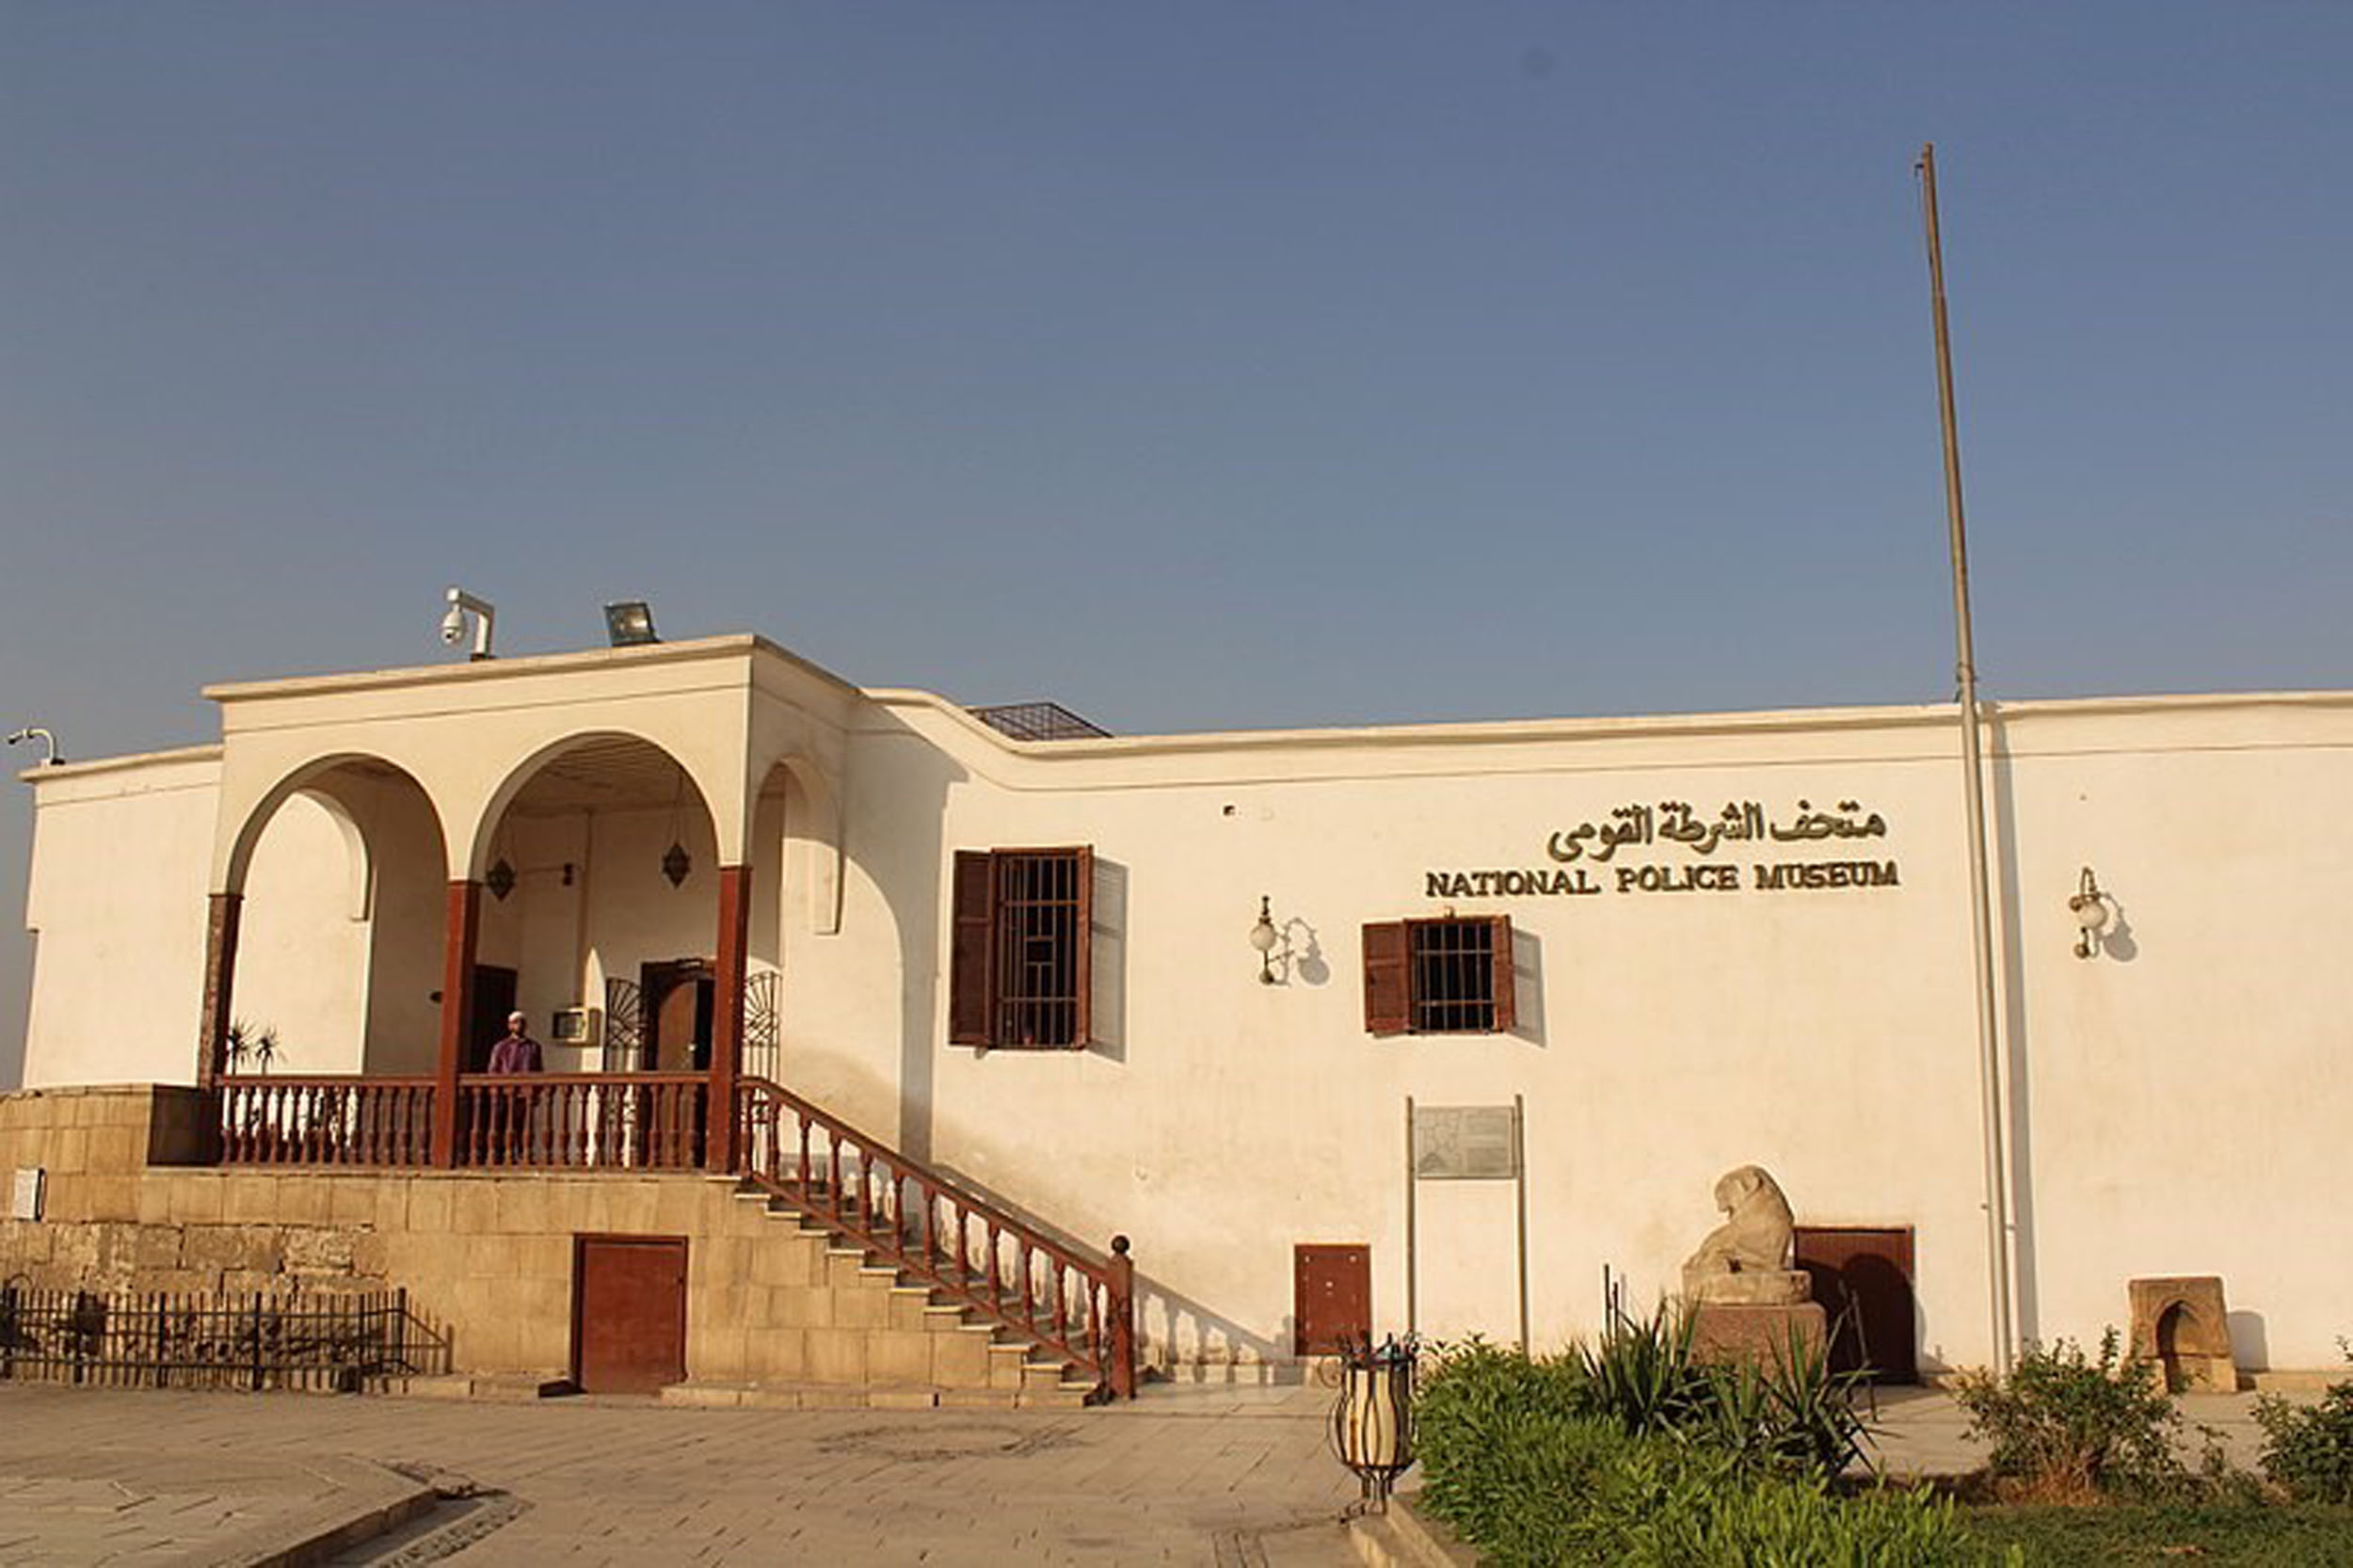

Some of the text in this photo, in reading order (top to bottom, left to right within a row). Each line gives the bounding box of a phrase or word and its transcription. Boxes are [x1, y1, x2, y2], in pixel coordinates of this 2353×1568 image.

[1658, 801, 1765, 855] الشرطة
[1770, 800, 1886, 841] متحف
[1426, 860, 1900, 898] NATIONAL POLICE MUSEUM
